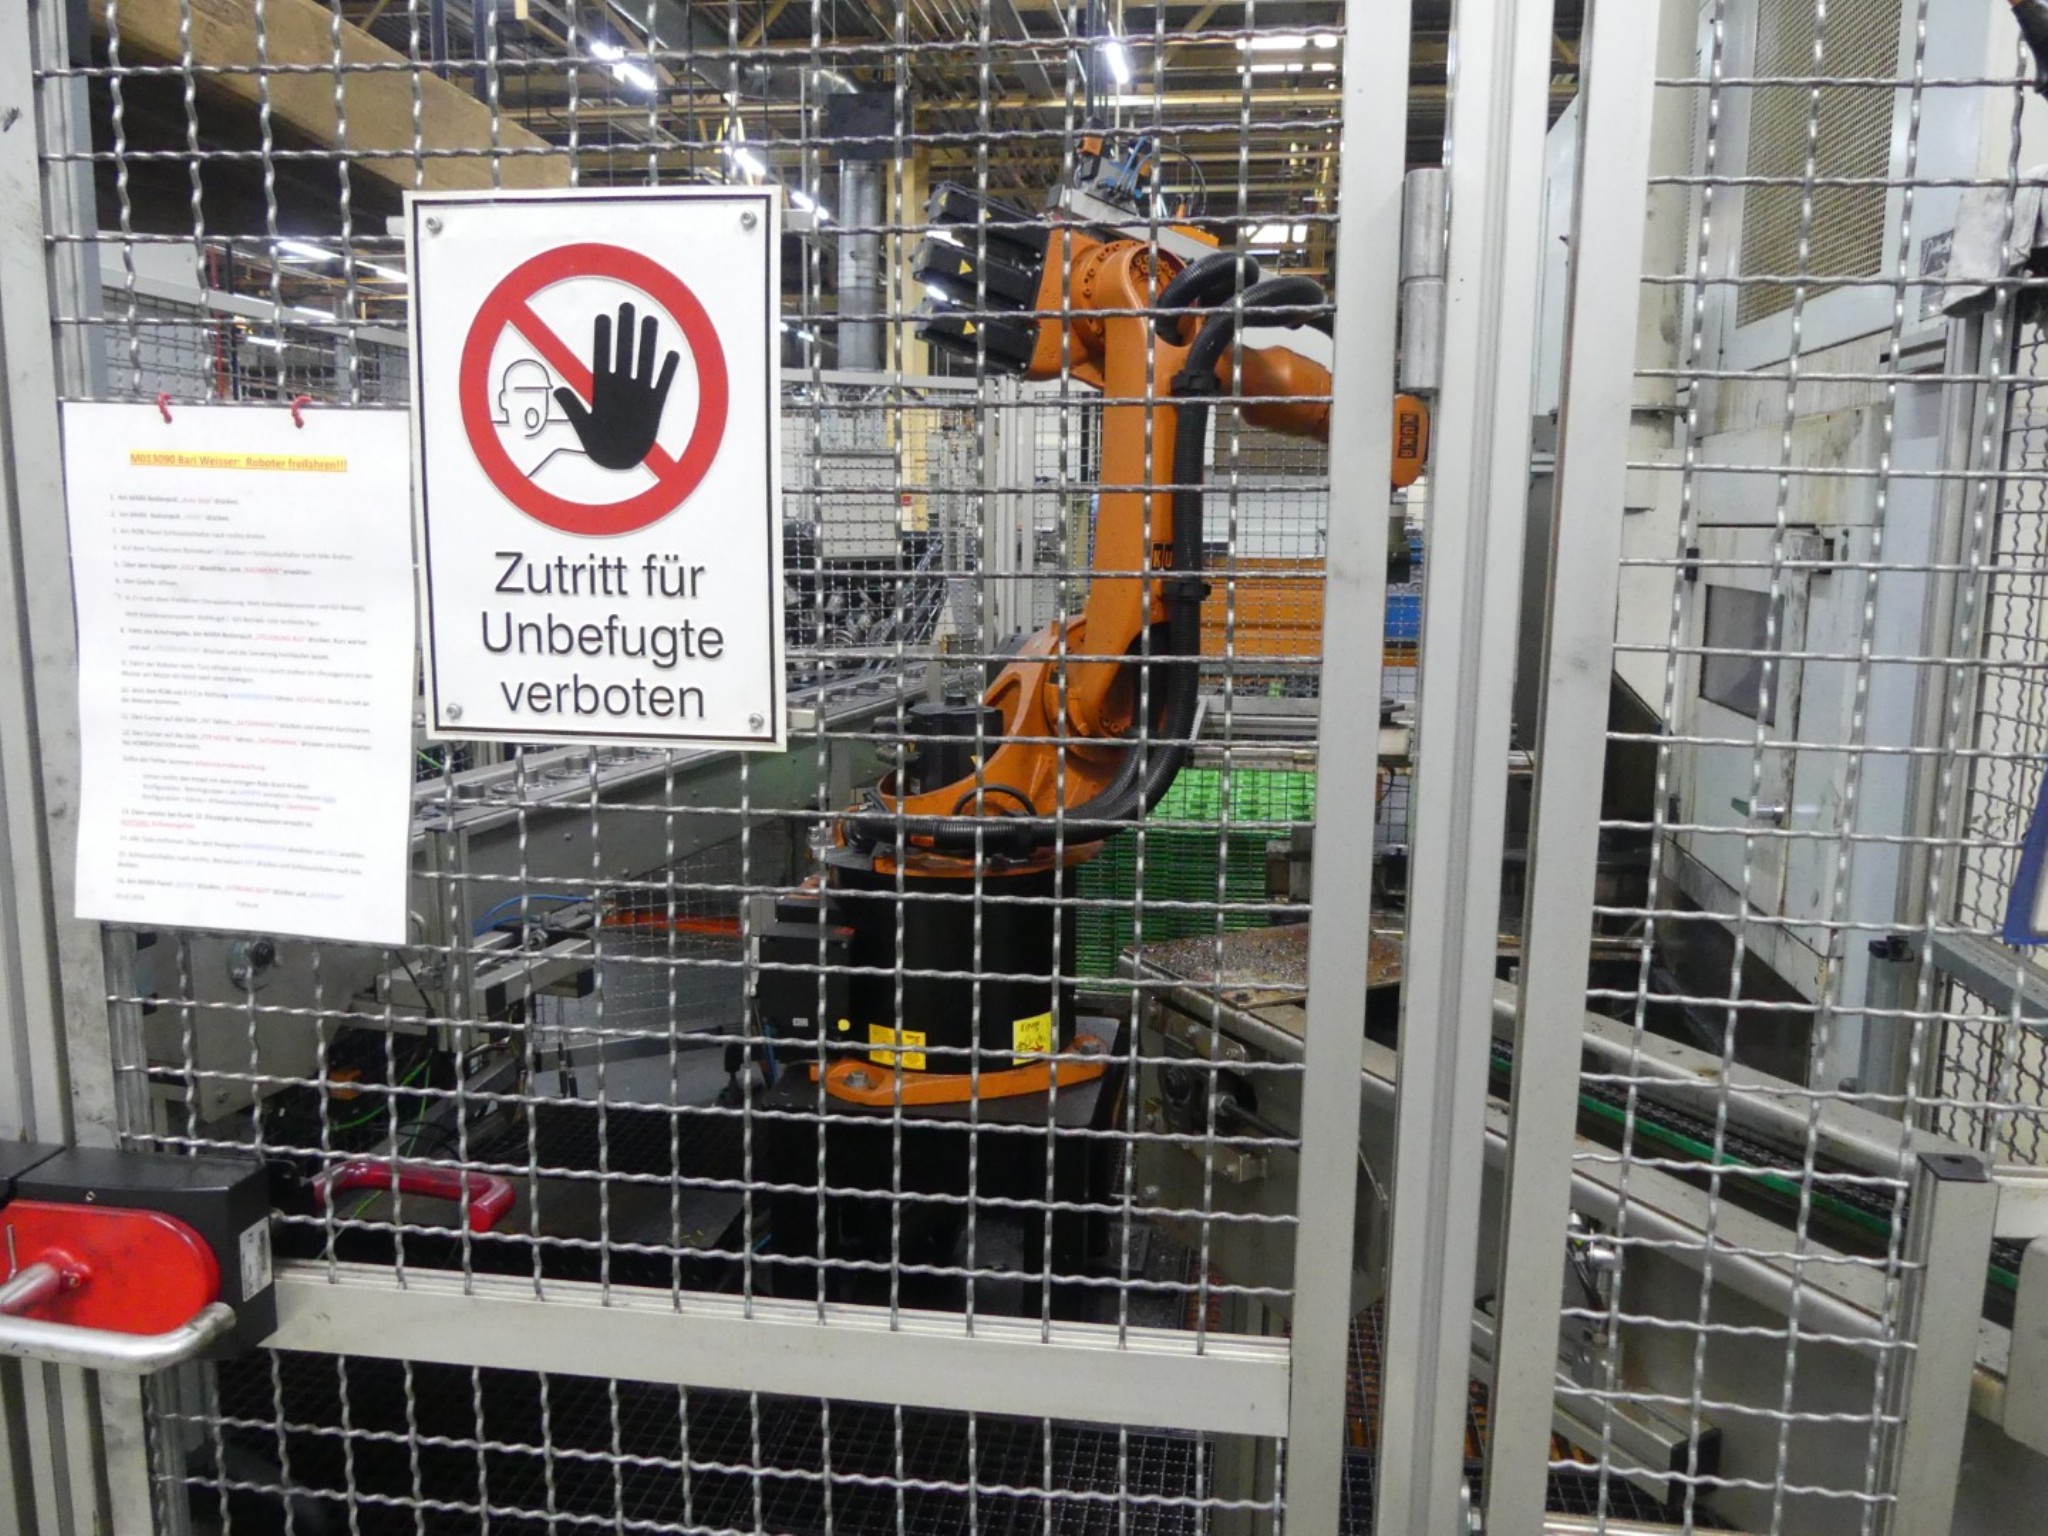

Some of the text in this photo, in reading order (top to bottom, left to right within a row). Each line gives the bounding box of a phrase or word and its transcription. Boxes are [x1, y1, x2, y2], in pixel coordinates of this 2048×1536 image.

[246, 457, 285, 468] Roboter
[494, 550, 706, 599] Zutritt für
[481, 611, 725, 670] Unbefugte
[500, 673, 705, 719] verboten
